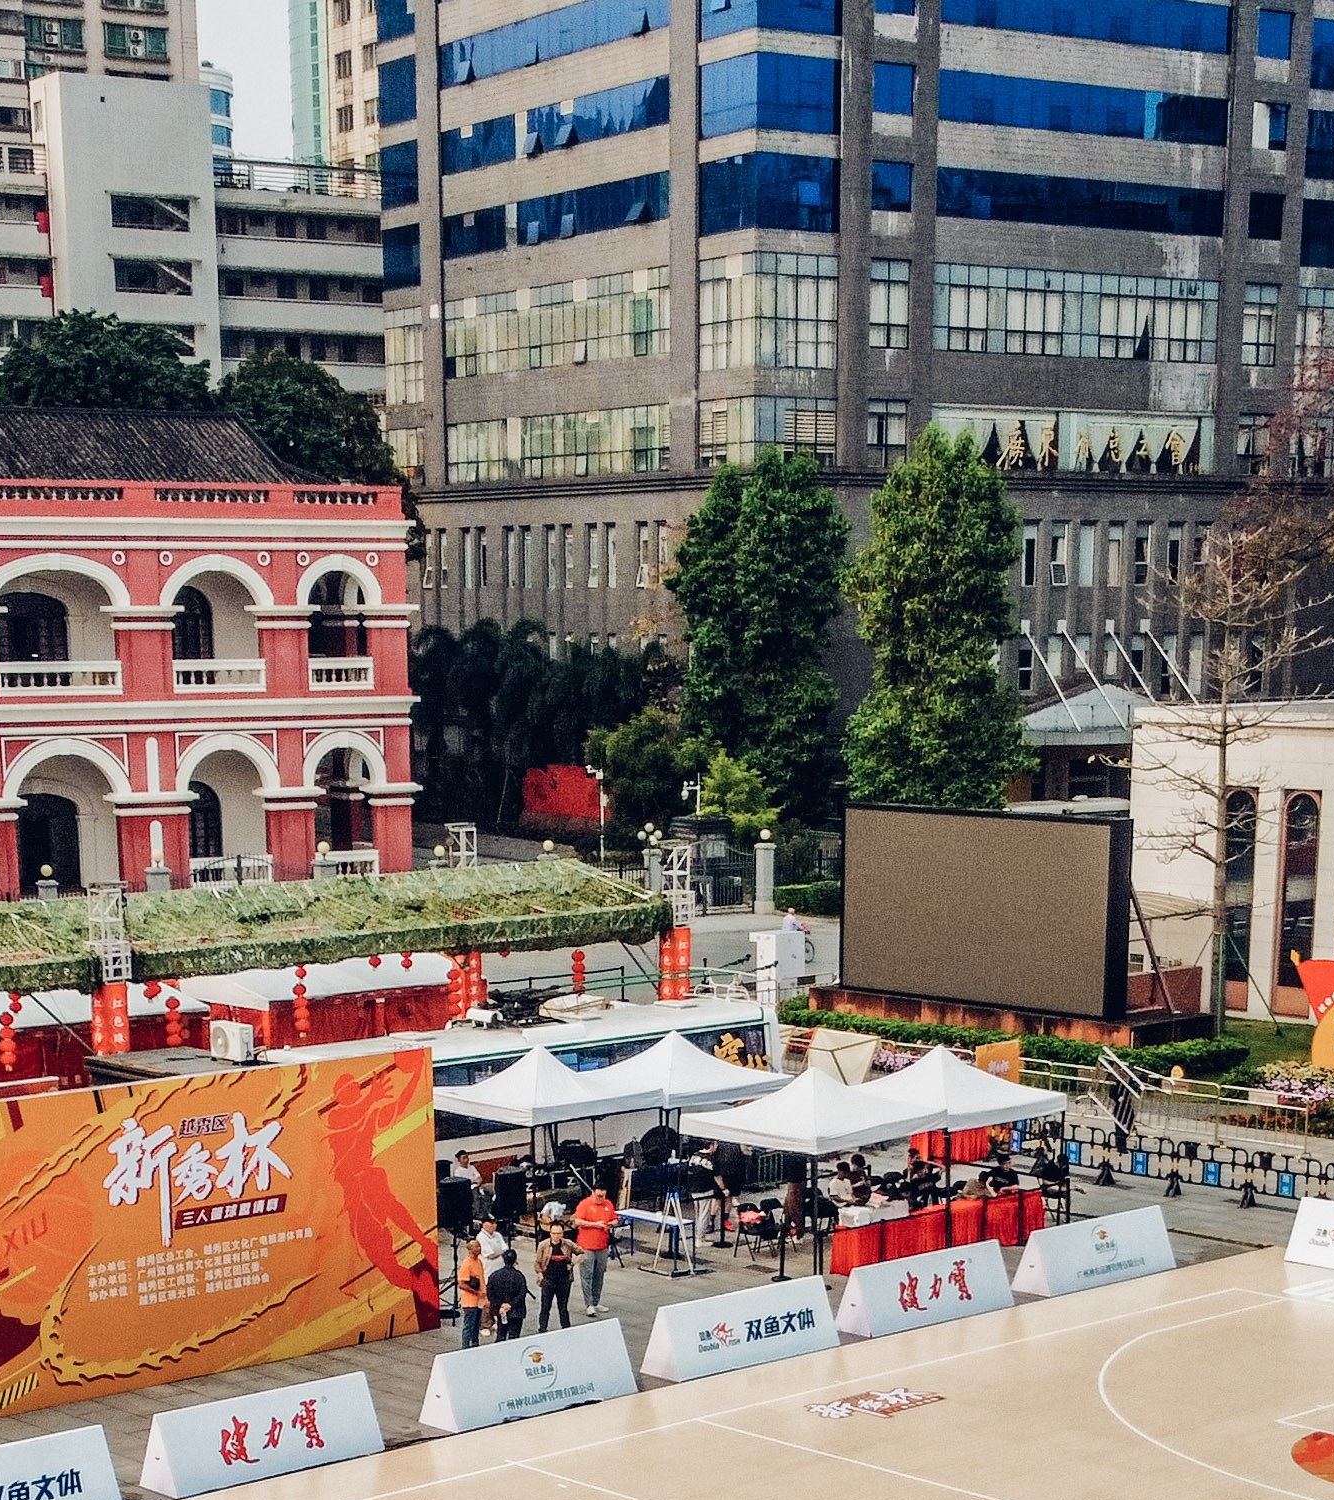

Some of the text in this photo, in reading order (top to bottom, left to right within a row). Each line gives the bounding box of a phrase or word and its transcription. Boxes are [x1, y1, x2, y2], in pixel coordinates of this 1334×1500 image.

[178, 1114, 230, 1138] 越秀区
[103, 1112, 293, 1247] 新秀杯
[744, 1308, 815, 1343] 双鱼文体
